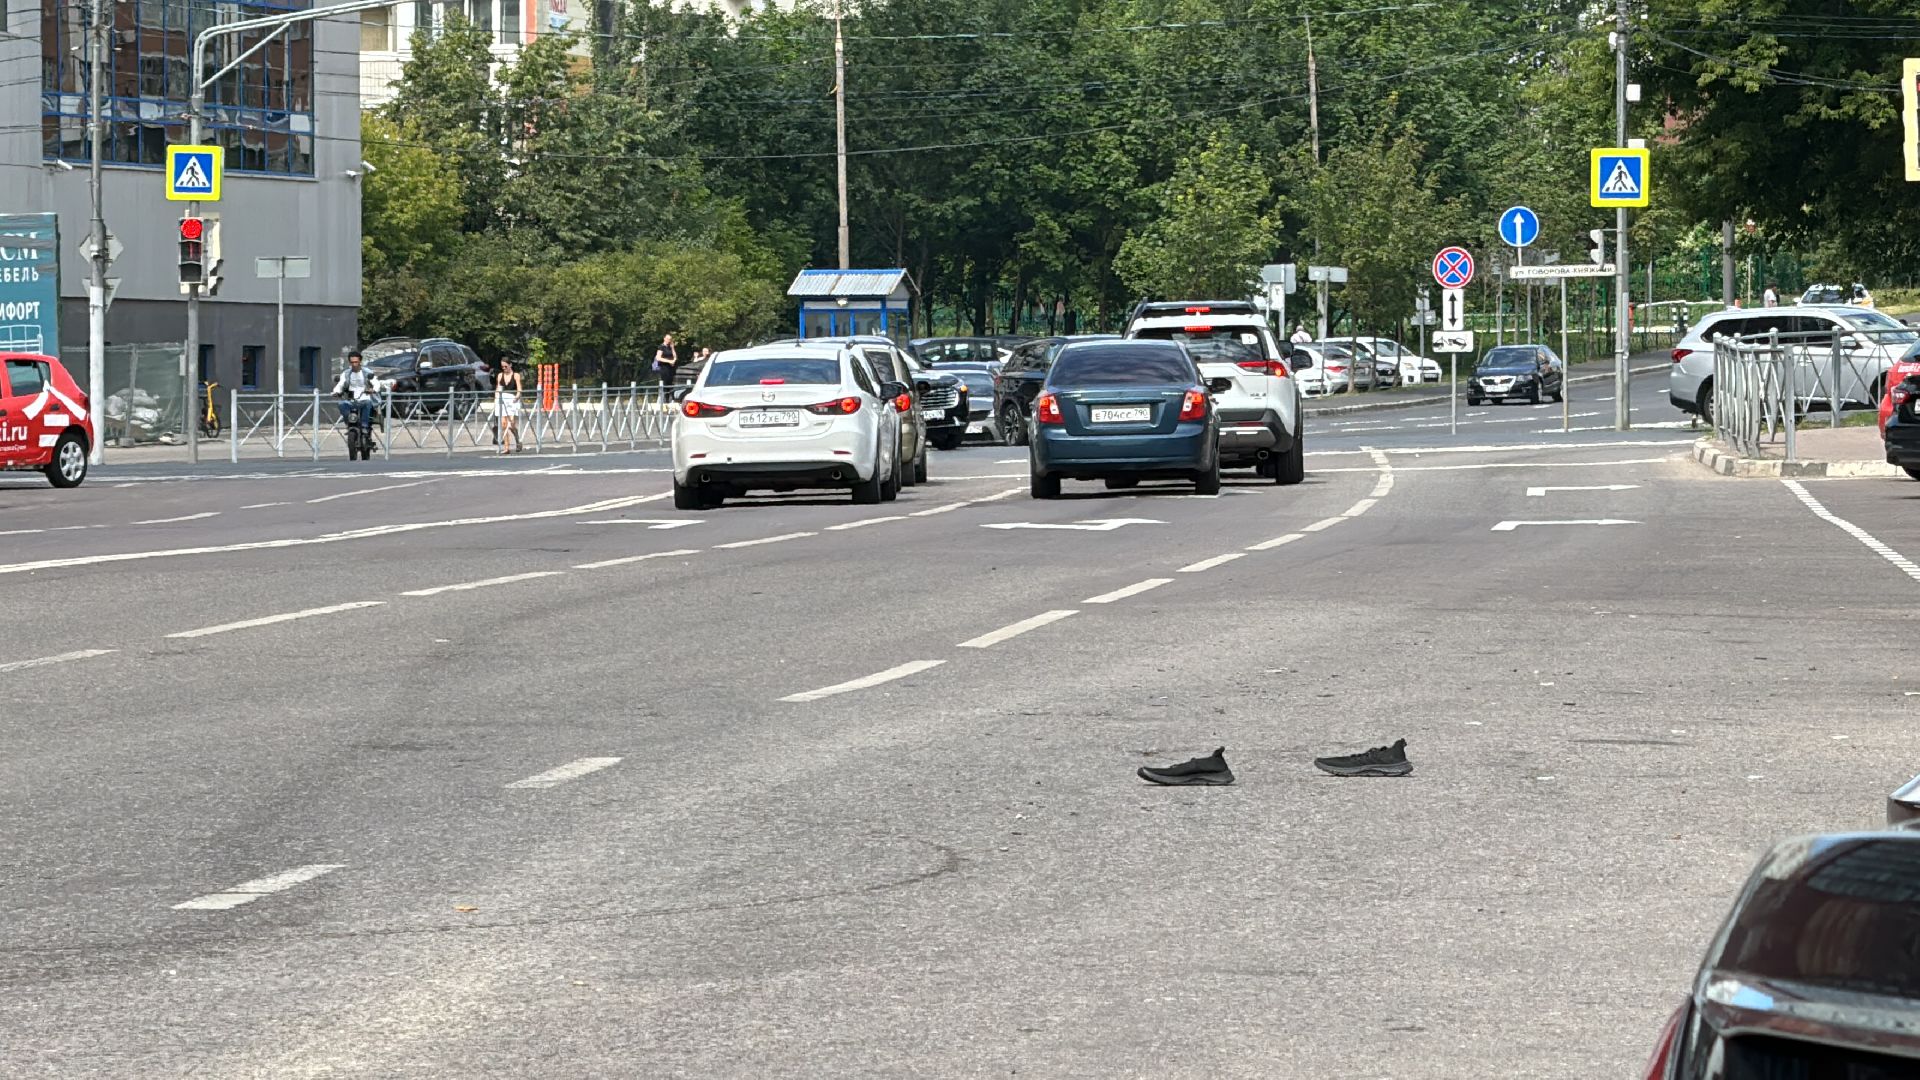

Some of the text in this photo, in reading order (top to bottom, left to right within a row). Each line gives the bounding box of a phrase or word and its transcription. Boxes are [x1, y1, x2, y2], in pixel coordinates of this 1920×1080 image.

[0, 232, 38, 261] СМ
[0, 267, 39, 282] БЕЛЬ
[0, 421, 28, 441] i.ru
